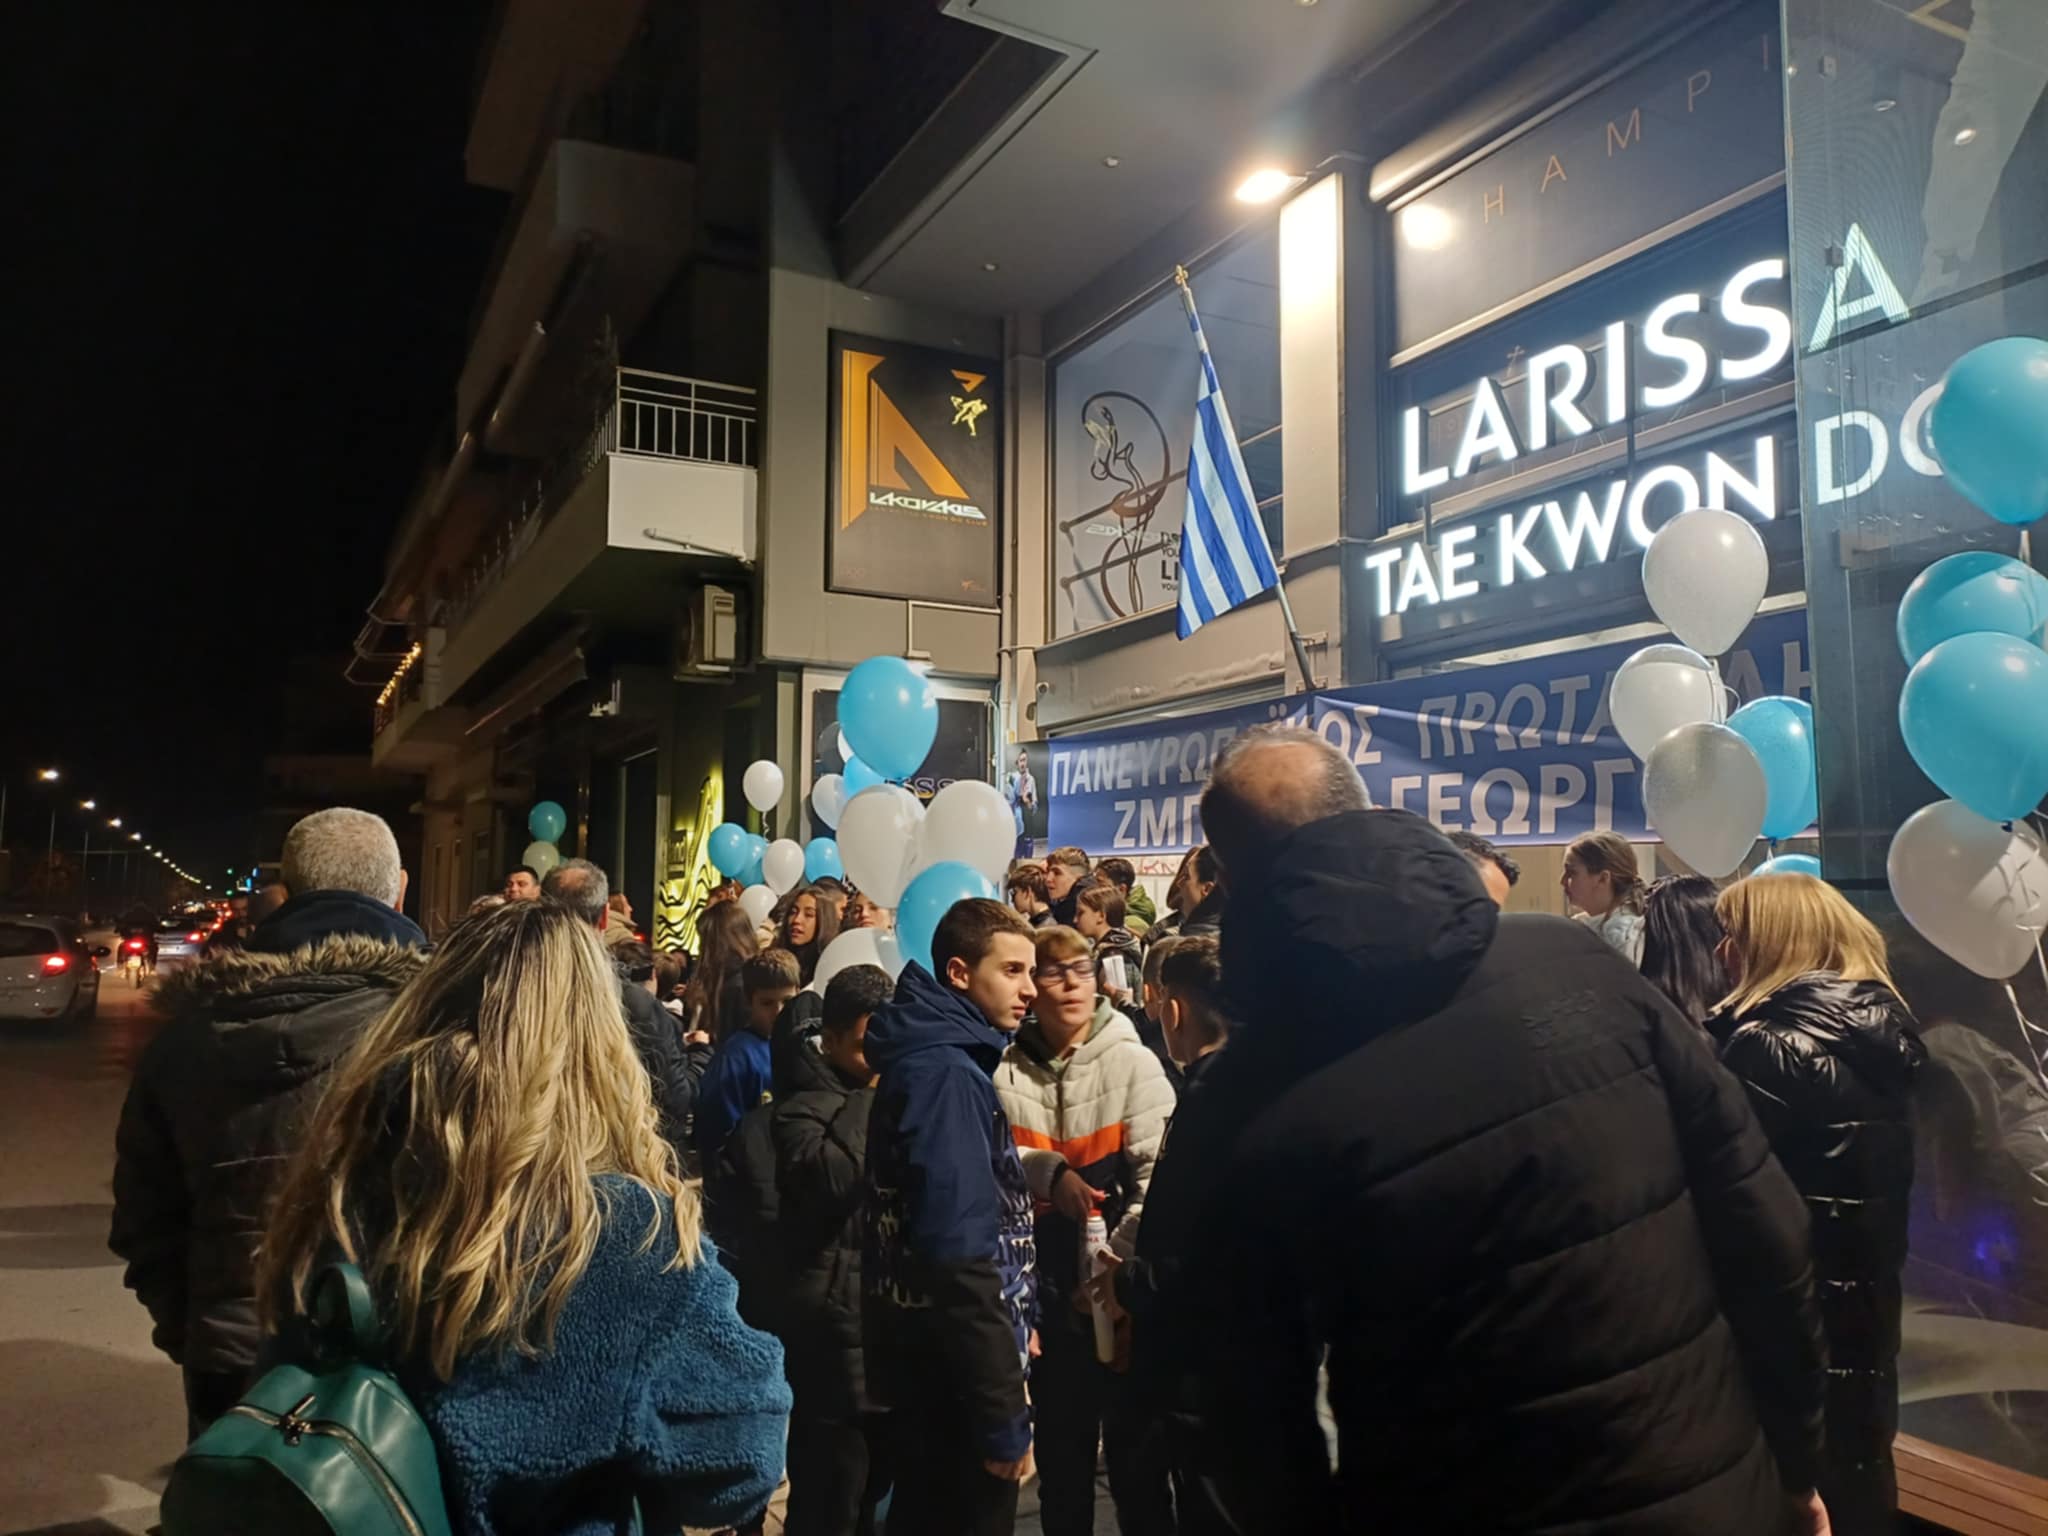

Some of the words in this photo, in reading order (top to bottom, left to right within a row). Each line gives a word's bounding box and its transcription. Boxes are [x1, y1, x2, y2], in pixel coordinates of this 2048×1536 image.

[1404, 222, 1911, 496] LARISSA
[1365, 524, 1480, 617] TAE
[1498, 435, 1778, 588] KWON
[1051, 703, 1382, 797] ΠΑΝΕΥΡΩΠΟΣ
[1391, 757, 1657, 836] ΓΕΩΡΓ
